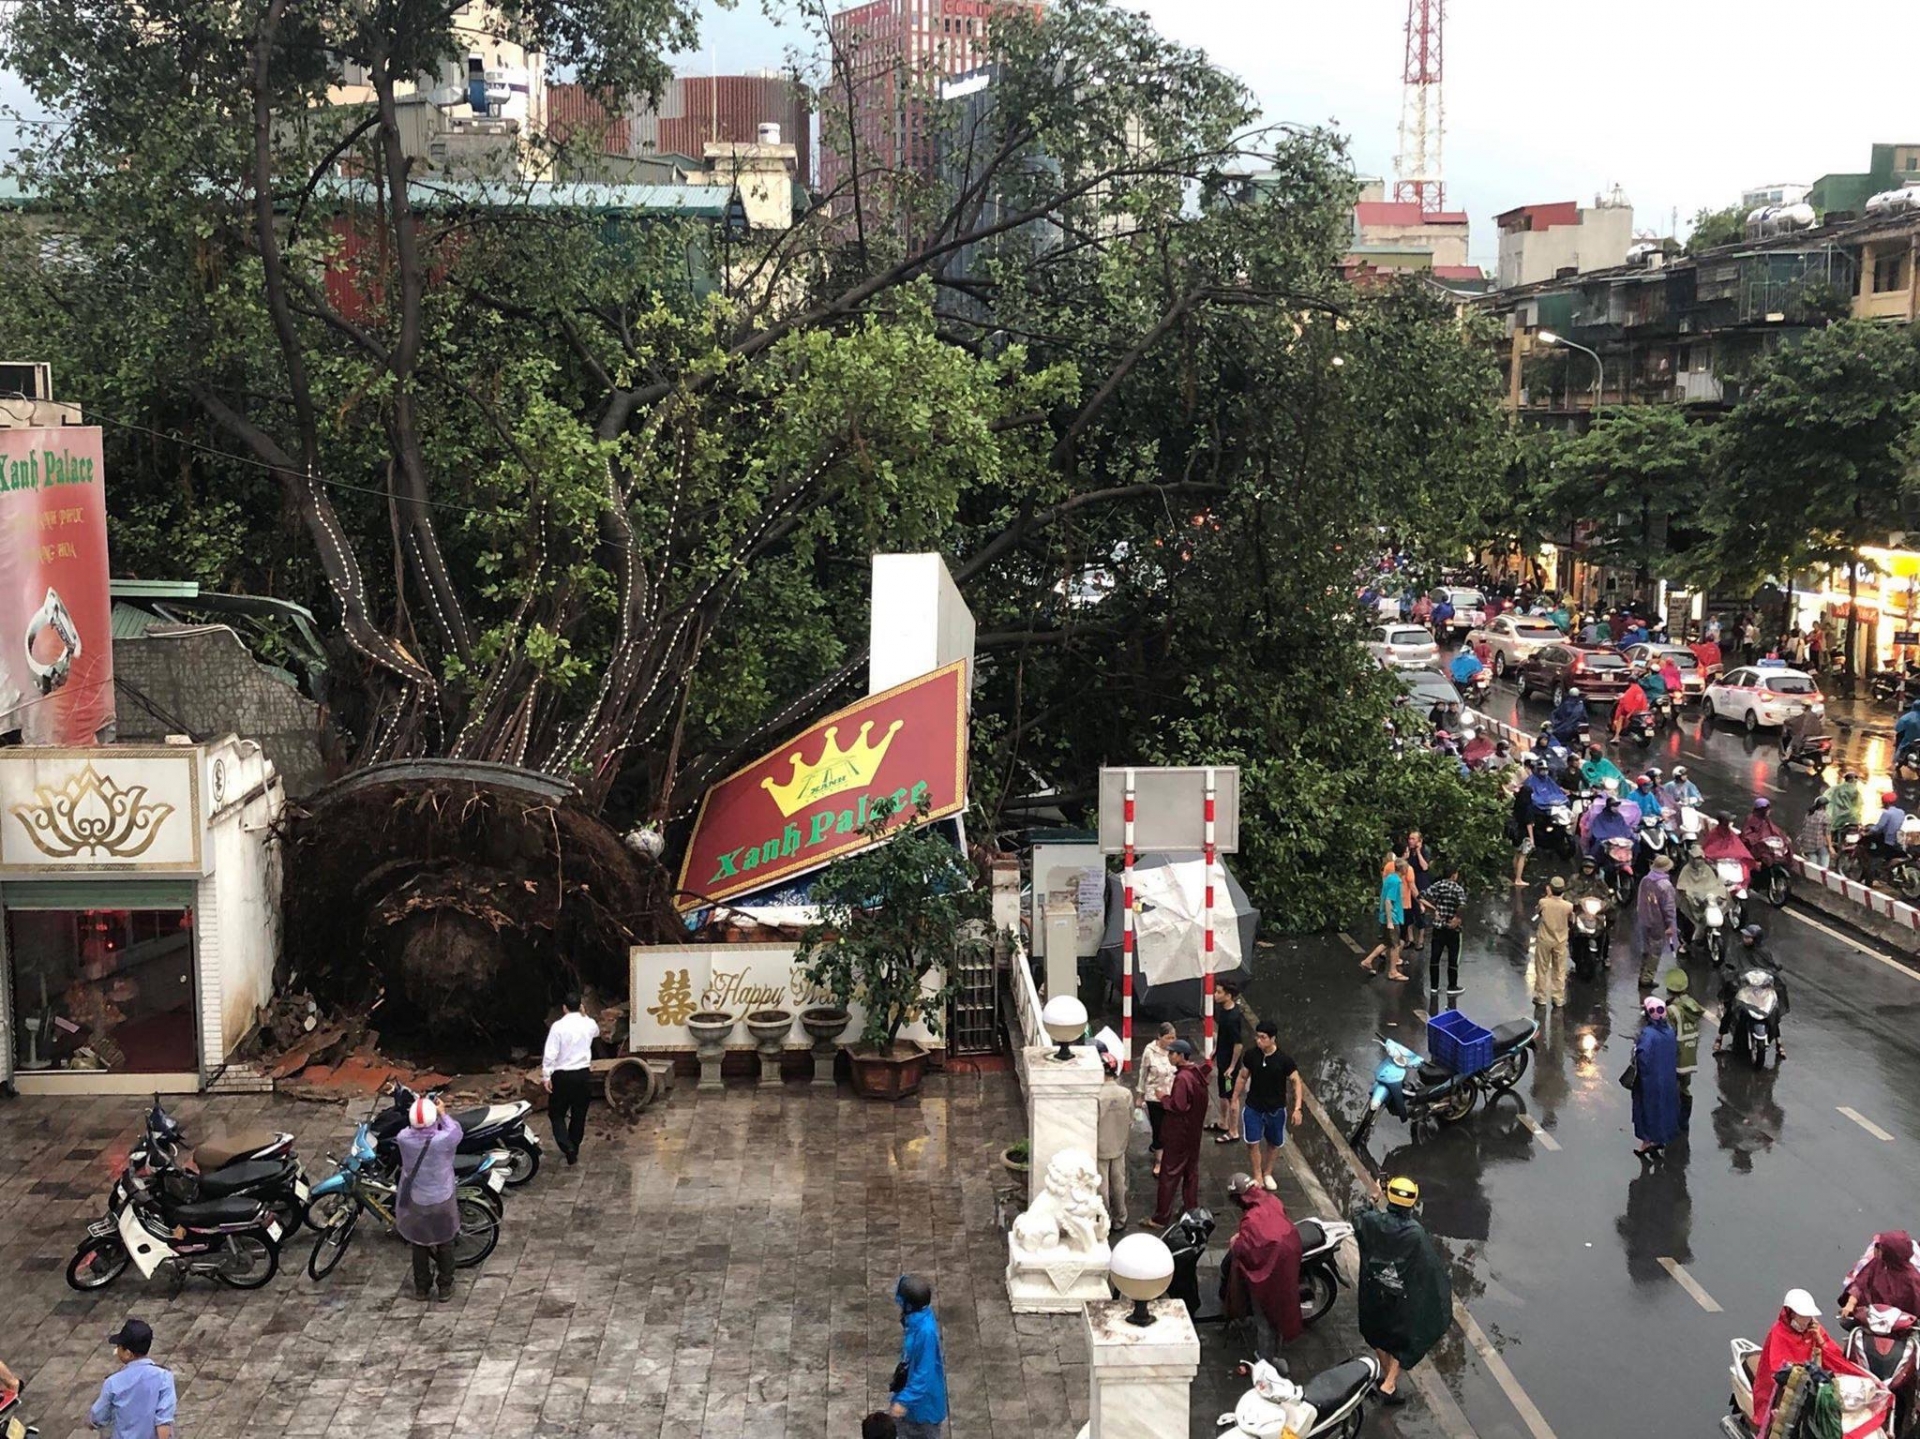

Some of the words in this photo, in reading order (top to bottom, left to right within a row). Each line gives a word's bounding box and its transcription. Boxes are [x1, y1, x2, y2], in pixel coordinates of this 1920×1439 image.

[44, 448, 94, 487] Palace
[706, 822, 801, 886] Xanh
[701, 966, 786, 1021] Happy
